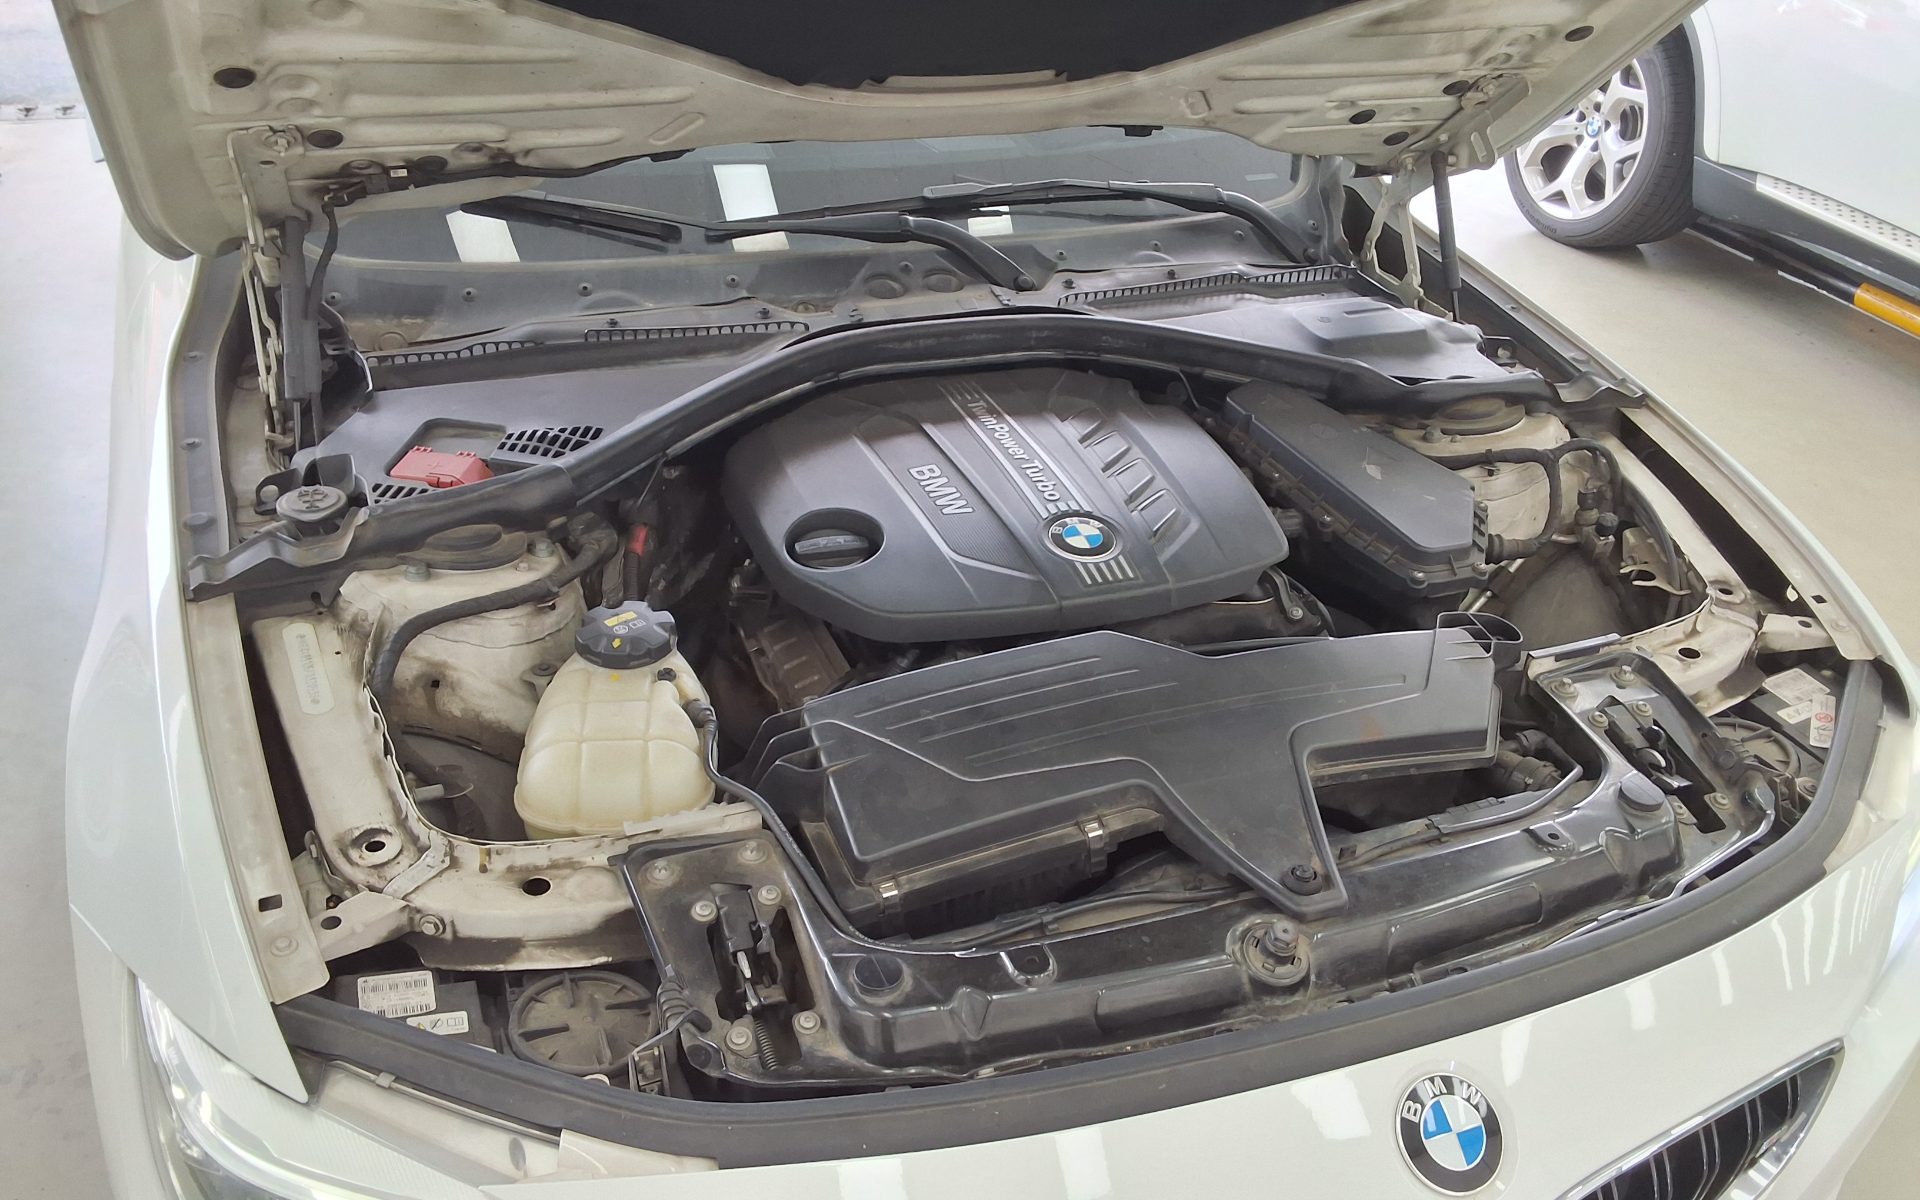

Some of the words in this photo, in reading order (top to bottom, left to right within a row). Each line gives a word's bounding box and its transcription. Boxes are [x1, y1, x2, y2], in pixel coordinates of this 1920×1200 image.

[967, 400, 1030, 460] TwinPower
[1021, 460, 1061, 501] Turbo
[908, 464, 975, 515] BMW
[1051, 518, 1103, 534] BMW
[1401, 1076, 1482, 1123] BMW
